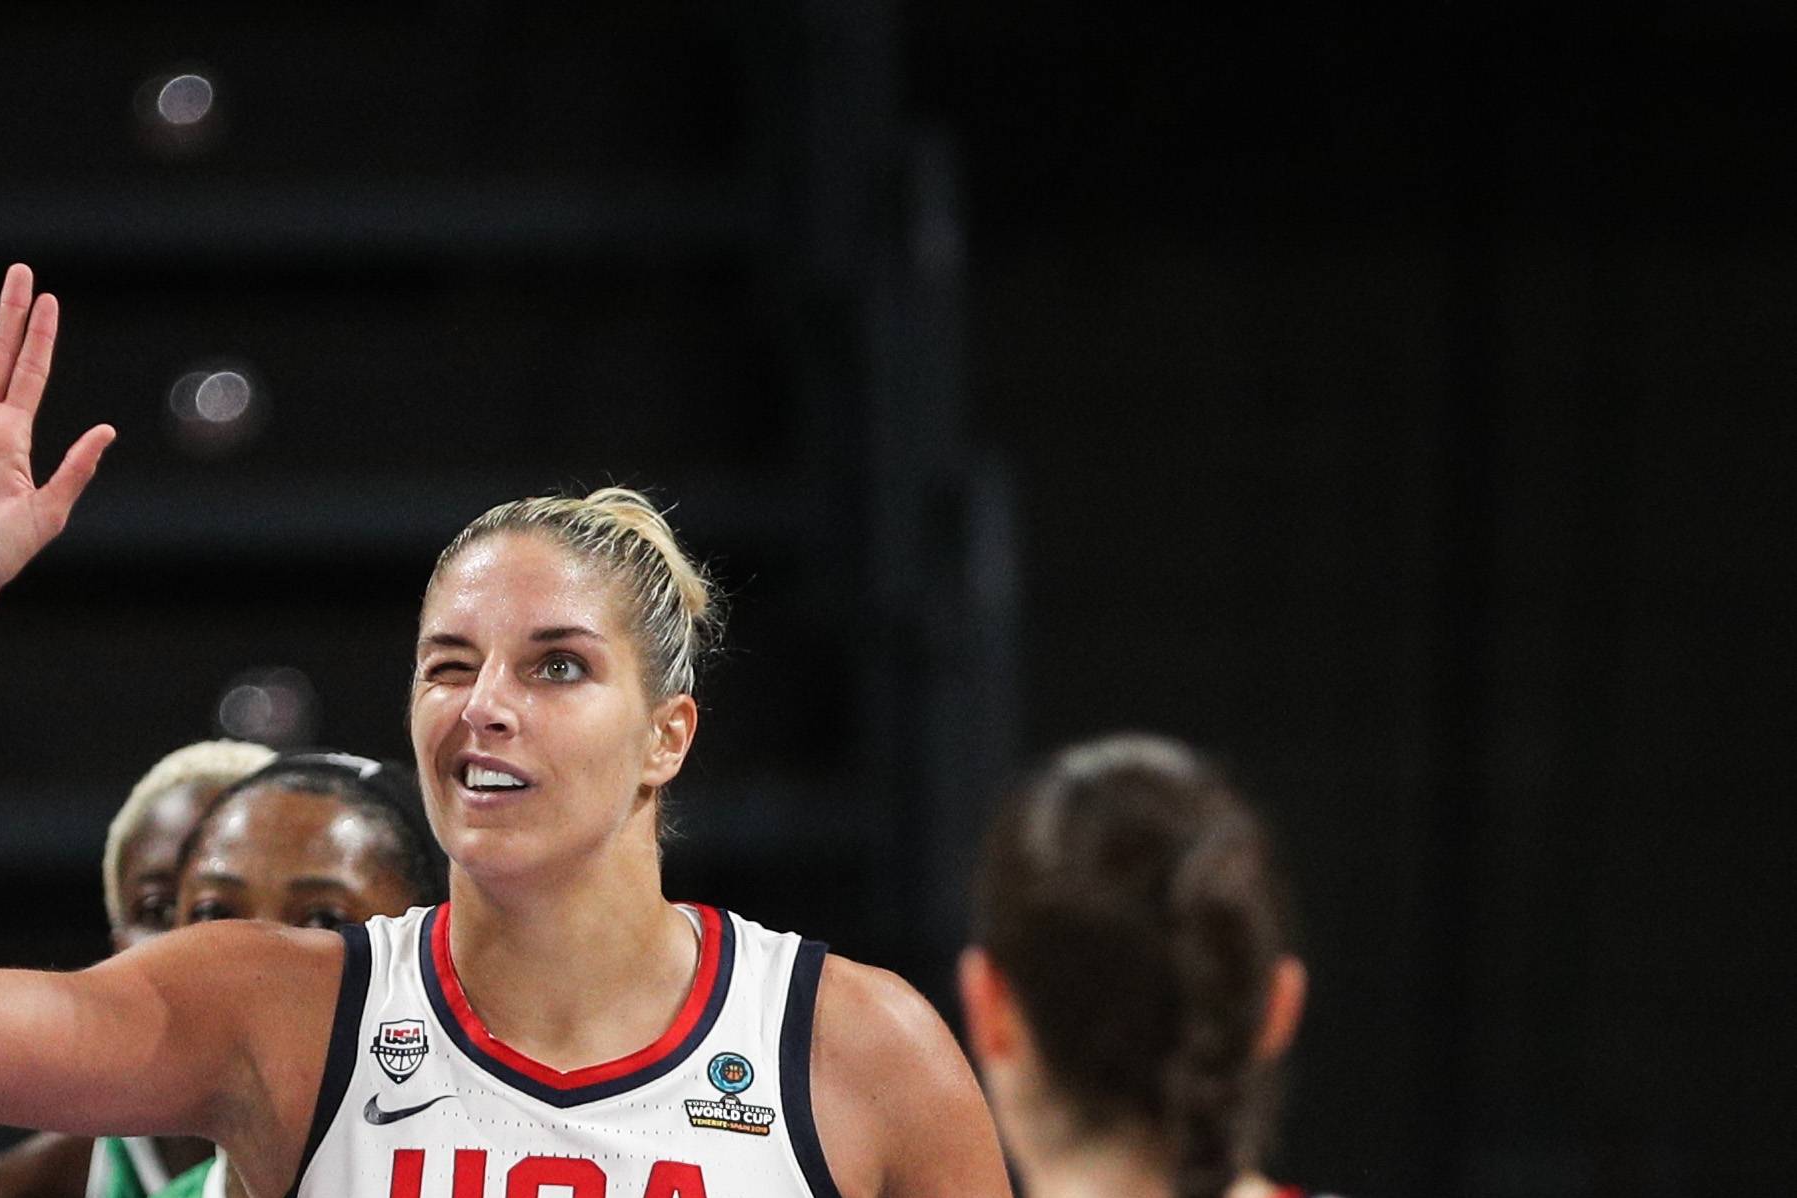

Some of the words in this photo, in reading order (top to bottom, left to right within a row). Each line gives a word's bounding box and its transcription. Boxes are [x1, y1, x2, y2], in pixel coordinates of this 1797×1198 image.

[384, 1027, 420, 1045] USA
[688, 1106, 740, 1121] WORLD
[743, 1112, 773, 1125] CUP
